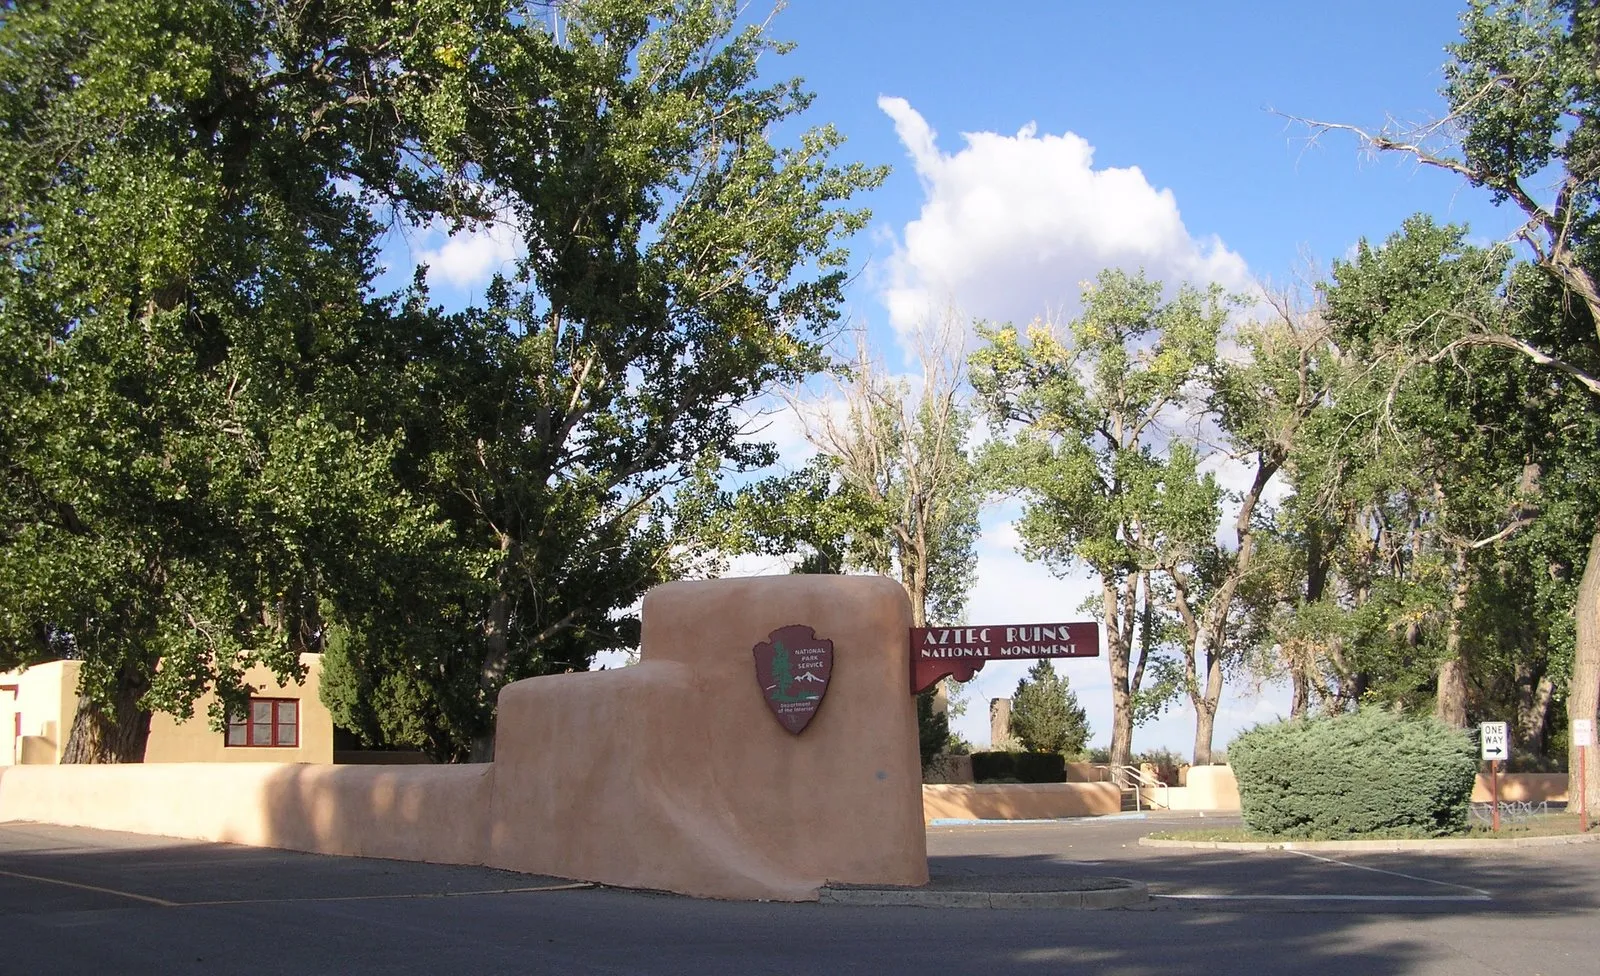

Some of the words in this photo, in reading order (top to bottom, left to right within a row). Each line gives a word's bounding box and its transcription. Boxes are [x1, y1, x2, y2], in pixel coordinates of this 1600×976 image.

[923, 628, 991, 645] AZTEC
[1006, 625, 1071, 643] RUINS
[921, 647, 991, 658] NATIONAL
[1000, 644, 1076, 656] MONUMENT
[1485, 726, 1503, 734] ONE
[1485, 736, 1503, 744] WAY
